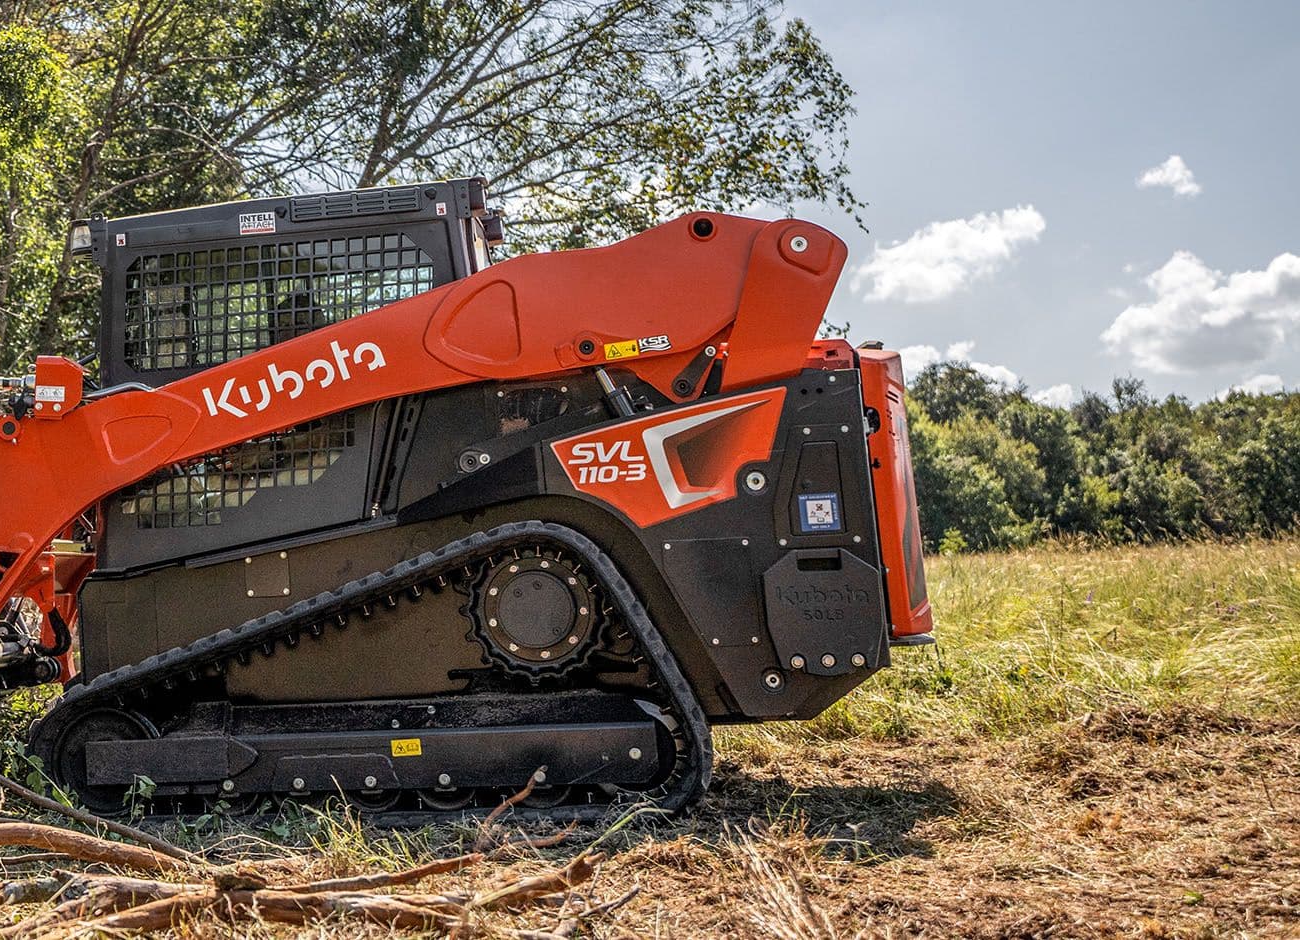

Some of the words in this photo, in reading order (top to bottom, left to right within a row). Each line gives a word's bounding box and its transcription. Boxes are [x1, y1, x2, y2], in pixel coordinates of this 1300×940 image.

[240, 214, 274, 222] INTELL
[638, 335, 669, 347] KSR
[202, 340, 386, 418] Kubota
[568, 441, 644, 464] SVL
[578, 463, 647, 484] 110-3
[775, 584, 869, 606] Kubota
